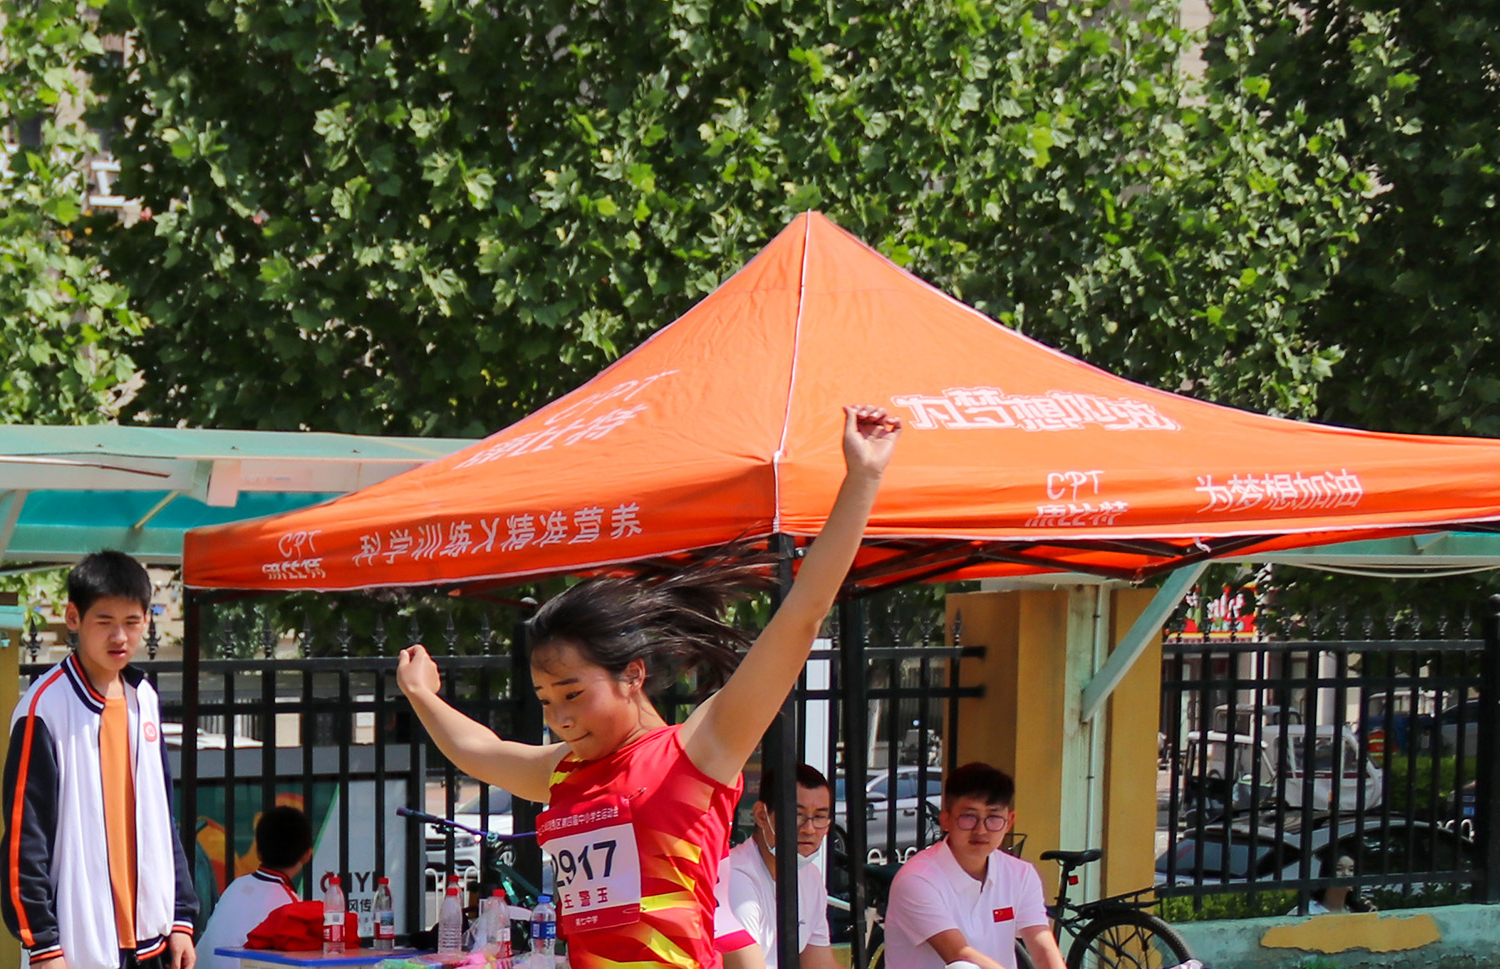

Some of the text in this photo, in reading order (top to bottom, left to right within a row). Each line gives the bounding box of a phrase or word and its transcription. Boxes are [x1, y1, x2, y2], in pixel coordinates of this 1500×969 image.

[1046, 470, 1106, 502] CPT
[1194, 468, 1364, 514] 为梦想加油
[1024, 500, 1130, 528] 康比特
[278, 529, 323, 560] CPT
